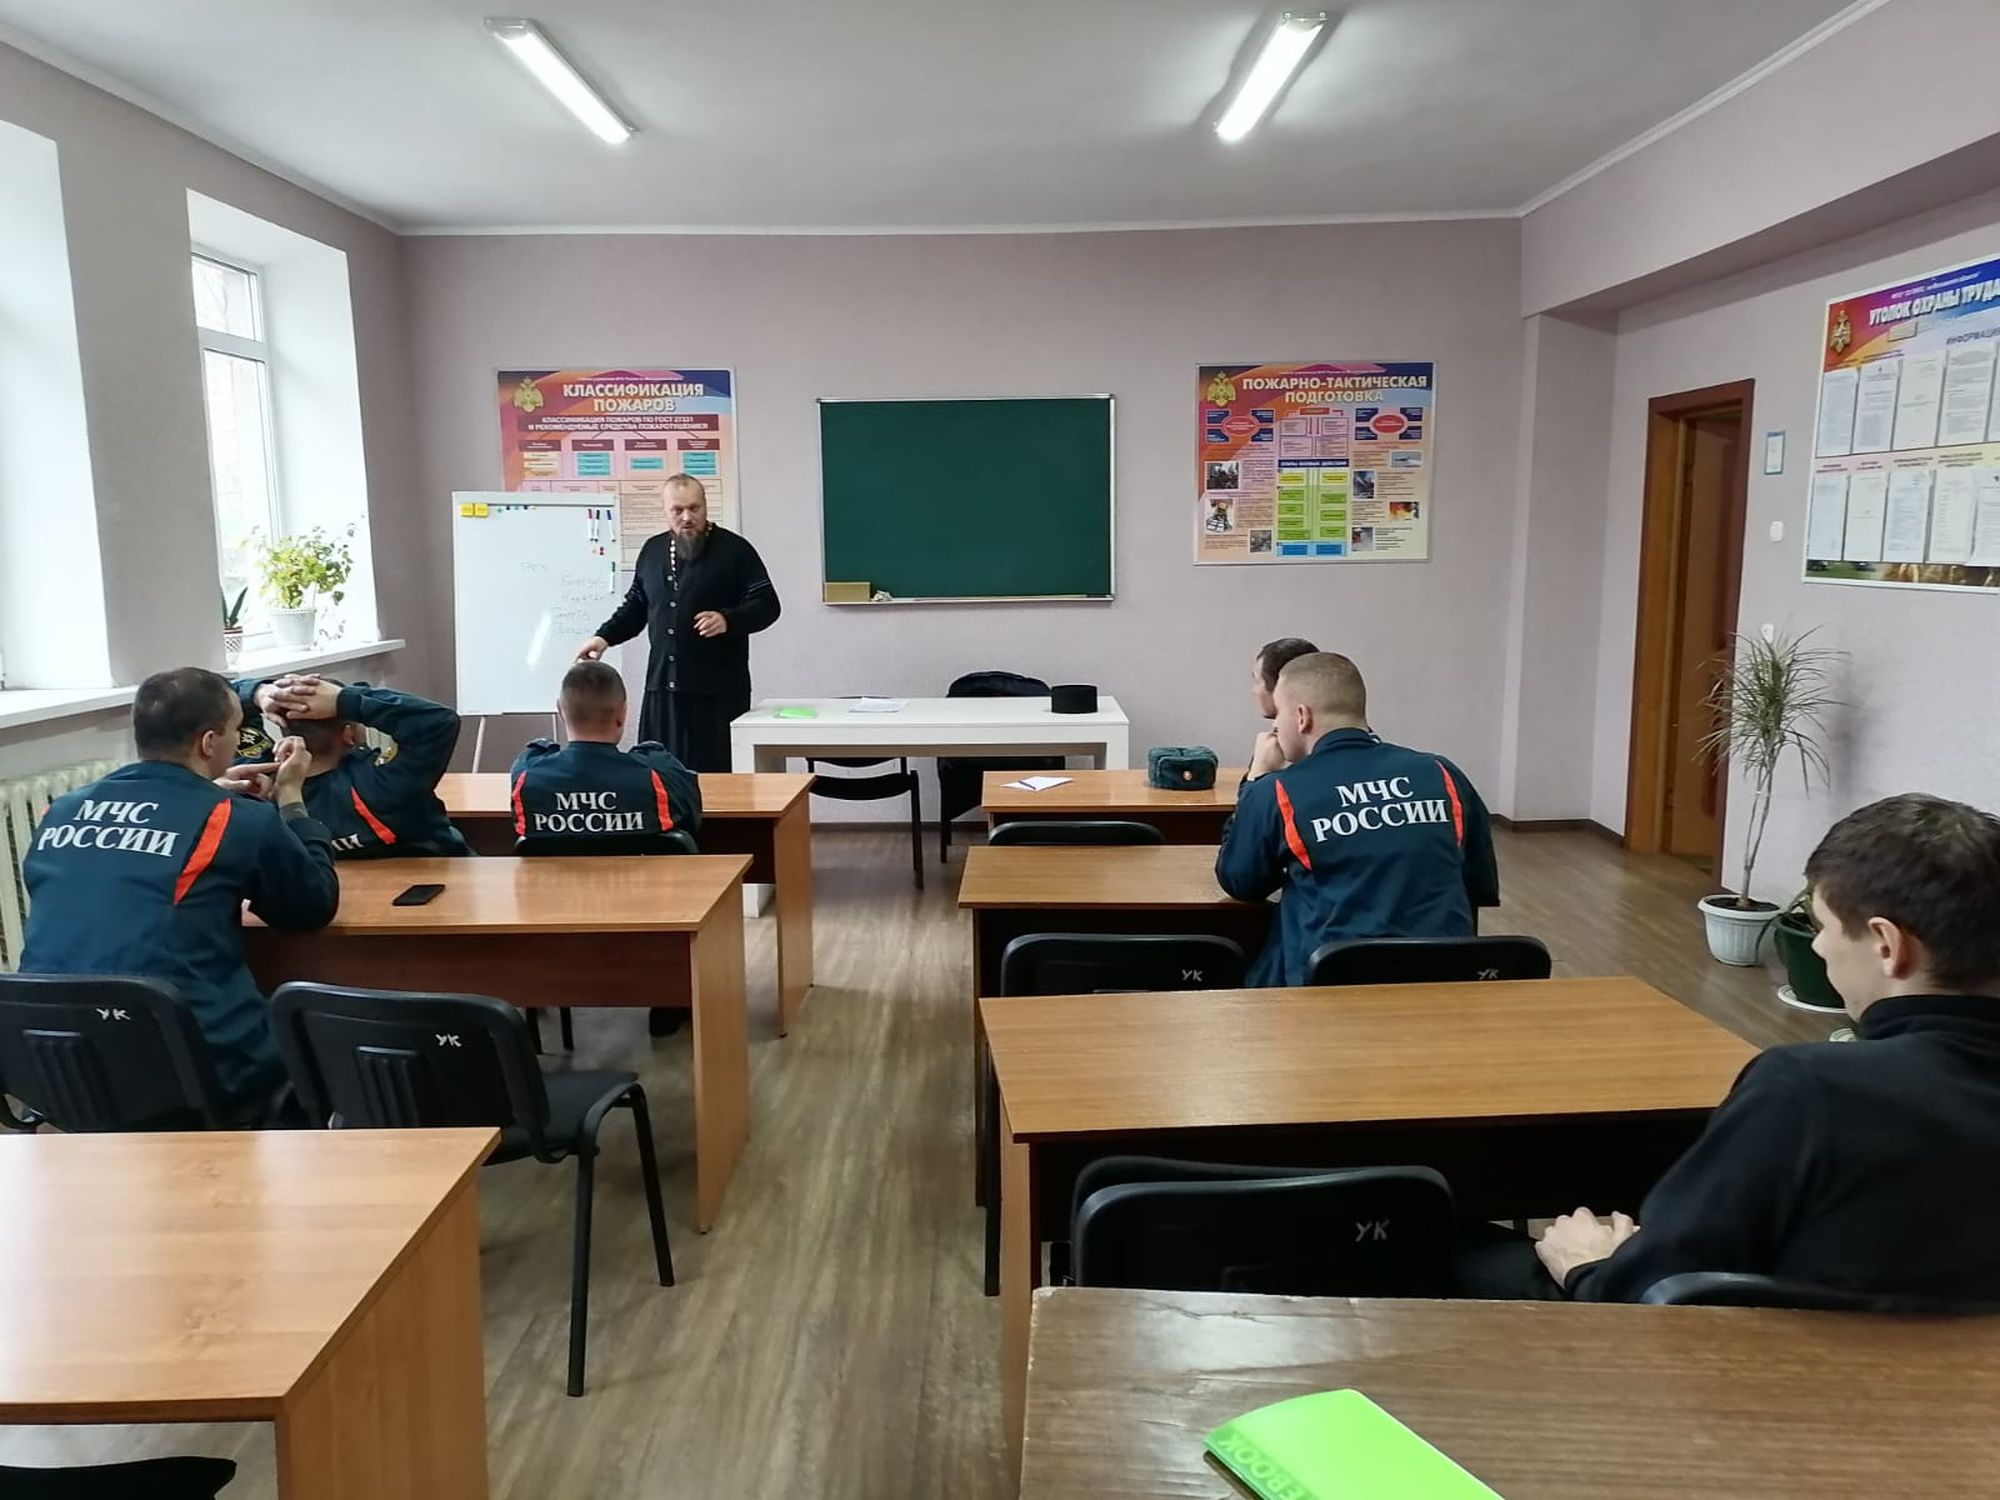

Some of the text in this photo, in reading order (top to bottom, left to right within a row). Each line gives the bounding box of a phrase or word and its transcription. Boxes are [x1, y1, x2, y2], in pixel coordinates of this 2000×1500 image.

[1869, 300, 1911, 326] УГОЛОК
[1912, 289, 1960, 317] ОХРАНЫ
[562, 383, 704, 397] КЛАССИФИКАЦИЯ
[1242, 376, 1427, 390] ПОЖАРНО-ТАКТИЧЕСКАЯ
[594, 399, 676, 412] ПОЖАРОВ
[1285, 390, 1384, 405] ПОДГОТОВКА
[605, 416, 642, 424] ПОЖАРОВ
[555, 791, 618, 811] МЧС
[1336, 776, 1414, 808] МЧС
[73, 799, 159, 824] МЧС
[1310, 799, 1450, 843] РОССИИ
[535, 812, 644, 832] РОССИИ
[37, 824, 180, 857] РОССИИ
[1181, 969, 1203, 982] УК
[96, 1007, 131, 1021] УК
[1355, 1219, 1390, 1242] УК
